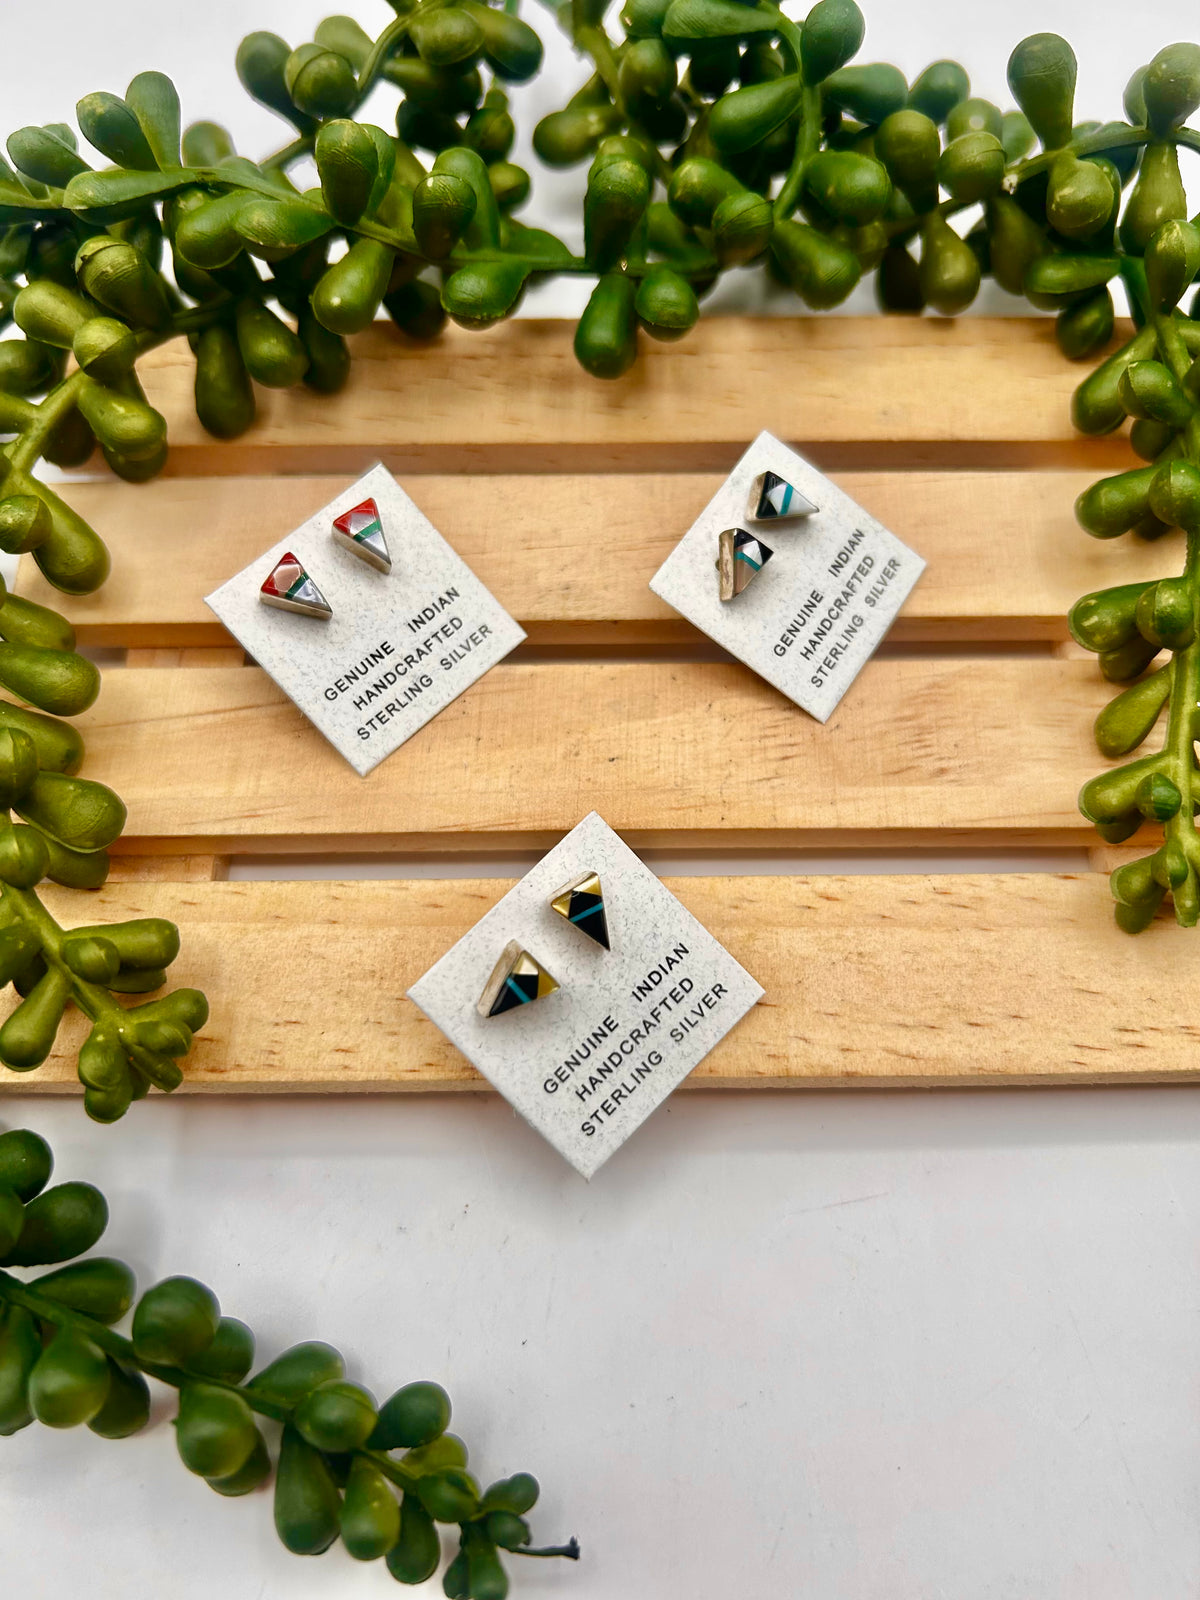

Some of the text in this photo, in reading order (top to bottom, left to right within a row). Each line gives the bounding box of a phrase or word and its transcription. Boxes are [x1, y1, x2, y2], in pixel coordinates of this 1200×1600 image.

[324, 586, 461, 701] GENUINE INDIAN
[773, 528, 866, 658] GENUINE INDIAN
[800, 555, 875, 661] HANDCRAFTED
[810, 558, 902, 688] STERLING SILVER
[353, 616, 463, 711] HANDCRAFTED
[357, 623, 493, 741] STERLING SILVER
[543, 942, 690, 1095] GENUINE INDIAN
[575, 977, 694, 1102] HANDCRAFTED
[581, 982, 729, 1137] STERLING SILVER
